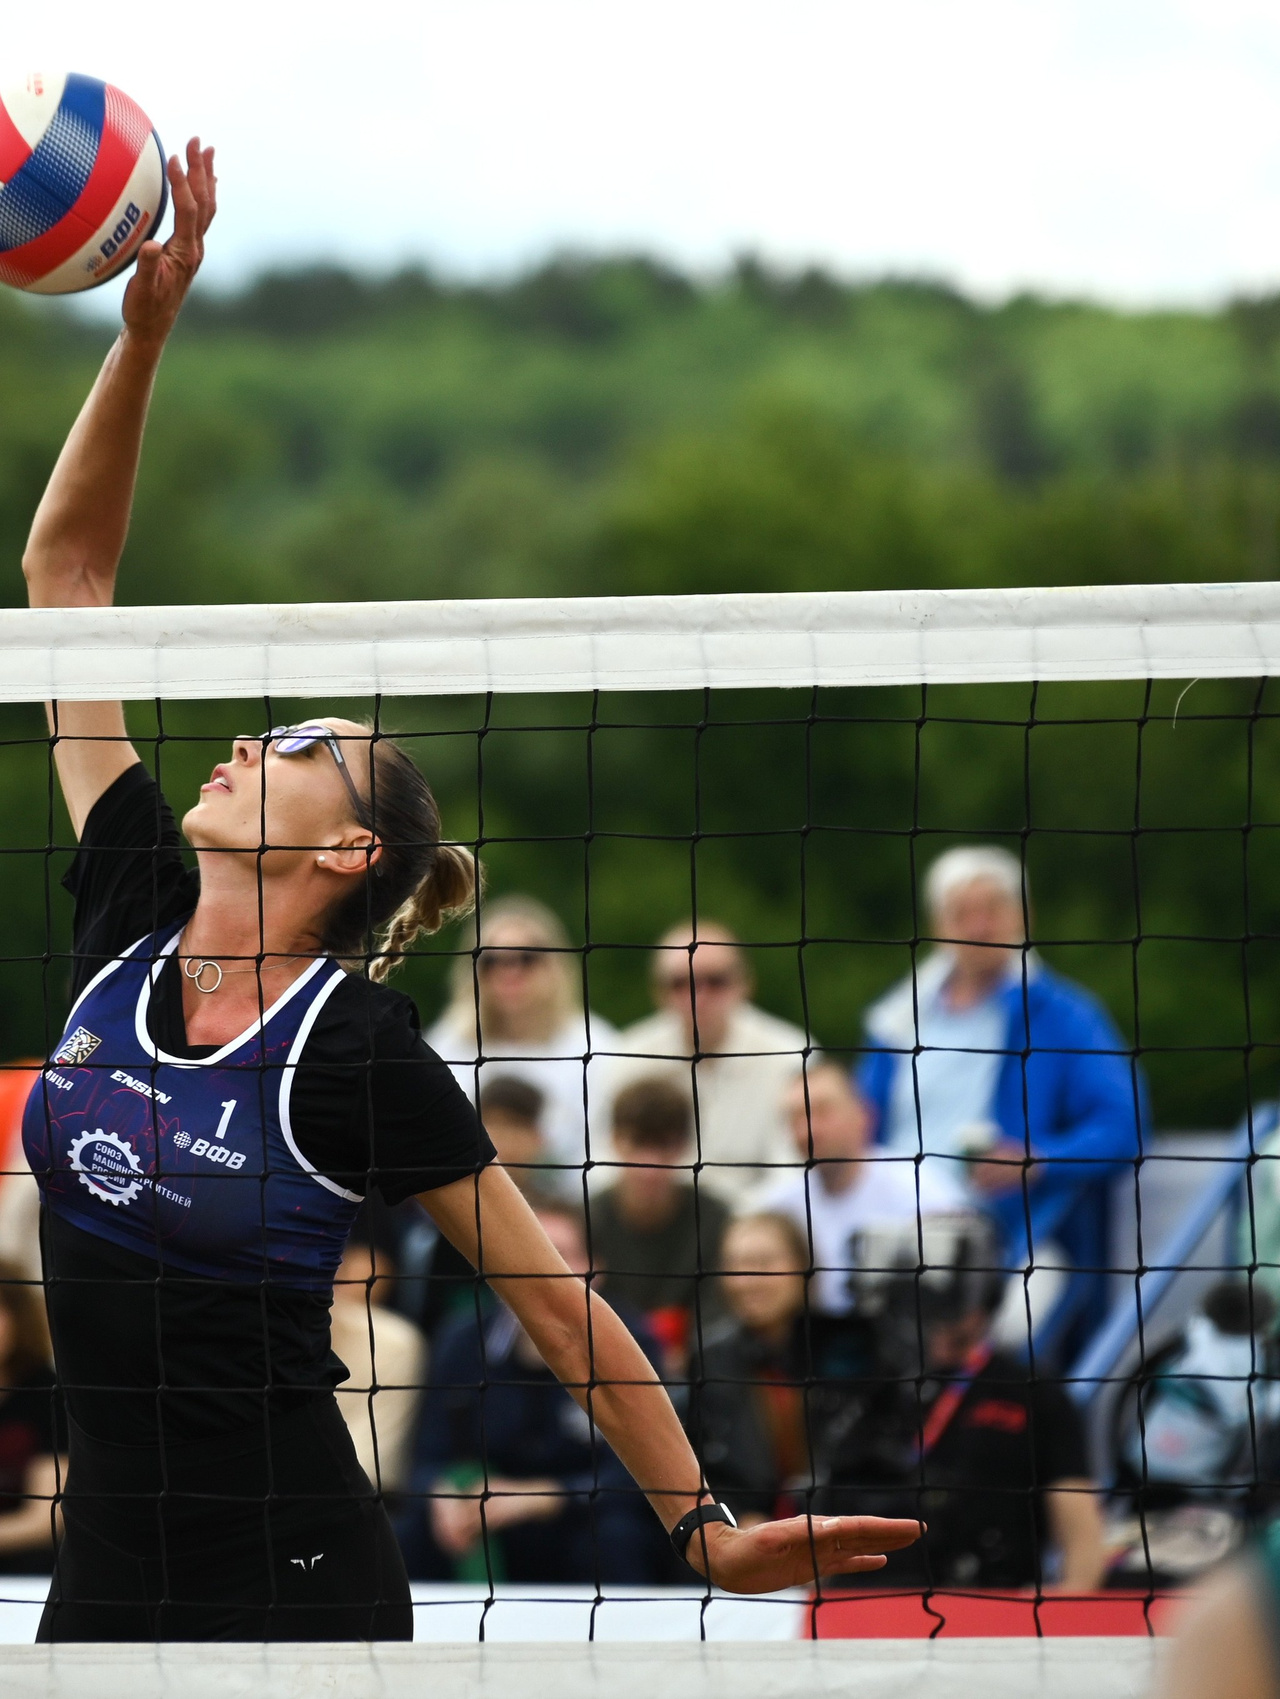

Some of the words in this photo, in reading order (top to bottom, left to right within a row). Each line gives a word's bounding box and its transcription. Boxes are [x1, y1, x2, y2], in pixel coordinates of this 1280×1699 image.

[99, 201, 141, 260] ВФВ
[109, 1069, 173, 1105] ENSEN
[214, 1099, 238, 1140] 1
[95, 1142, 123, 1161] СОЮЗ
[189, 1138, 247, 1170] ВФВ
